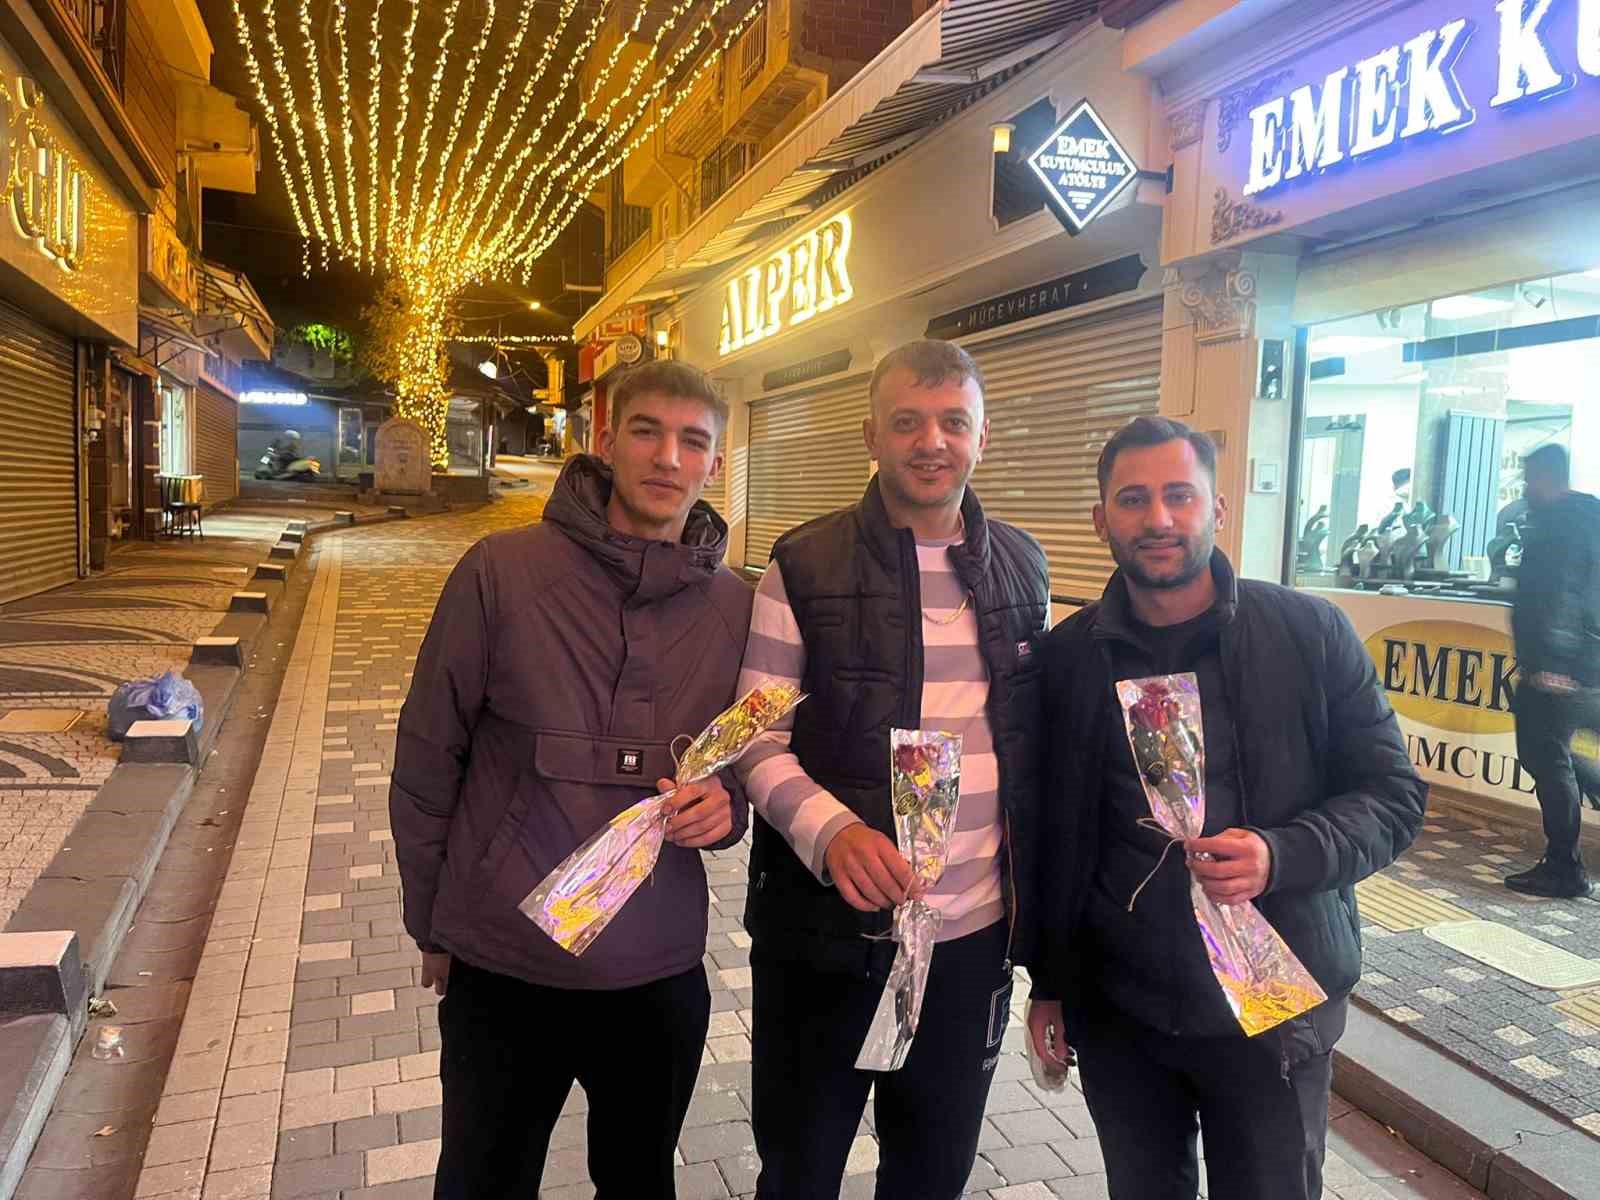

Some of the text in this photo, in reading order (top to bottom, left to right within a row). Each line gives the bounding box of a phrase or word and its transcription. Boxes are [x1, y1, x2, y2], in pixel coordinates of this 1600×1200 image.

[1242, 18, 1472, 197] EMEK
[1040, 155, 1126, 177] KUYUMCULUK
[1057, 136, 1111, 160] EMEK
[718, 210, 855, 356] ALPER
[967, 282, 1073, 329] MÜCEVHERAT
[1384, 639, 1521, 713] EMEK
